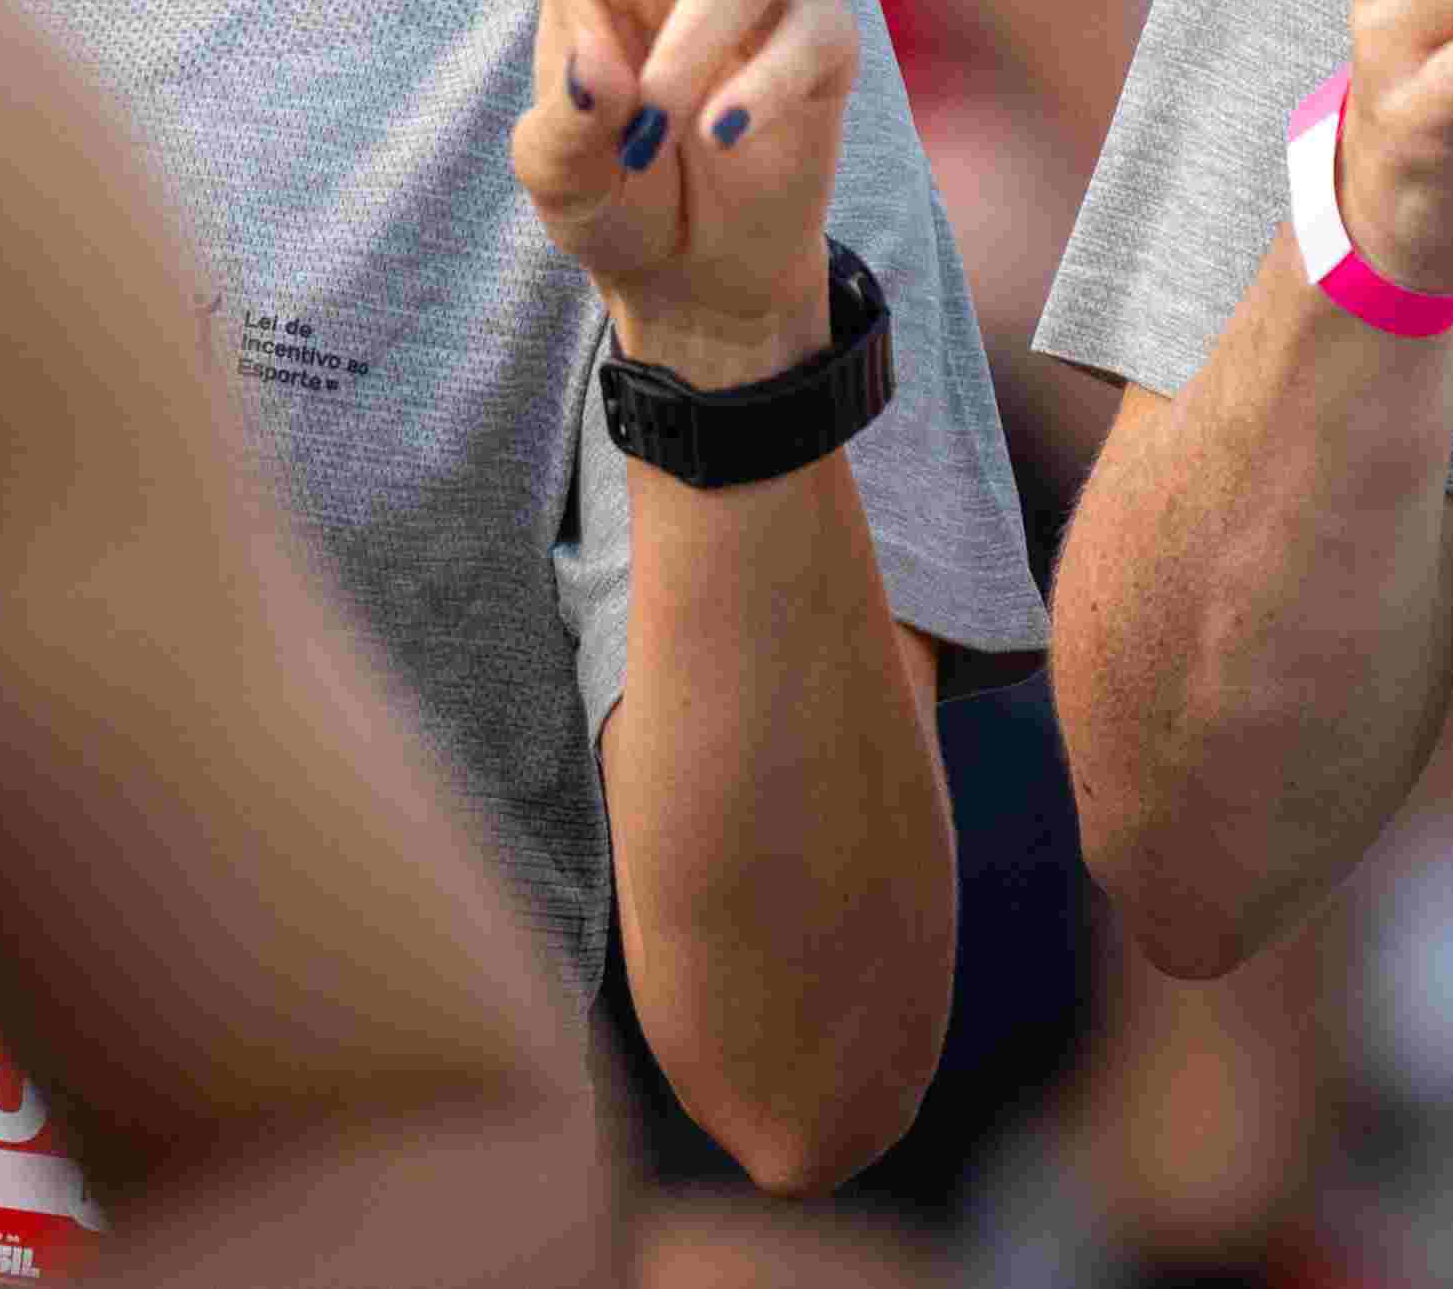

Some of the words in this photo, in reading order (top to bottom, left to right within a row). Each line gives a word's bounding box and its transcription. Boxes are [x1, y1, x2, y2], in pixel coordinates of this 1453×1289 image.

[245, 311, 278, 331] Lei
[285, 318, 313, 337] de
[243, 333, 342, 369] Incentivo
[348, 358, 369, 375] ao
[237, 357, 322, 390] Esporte
